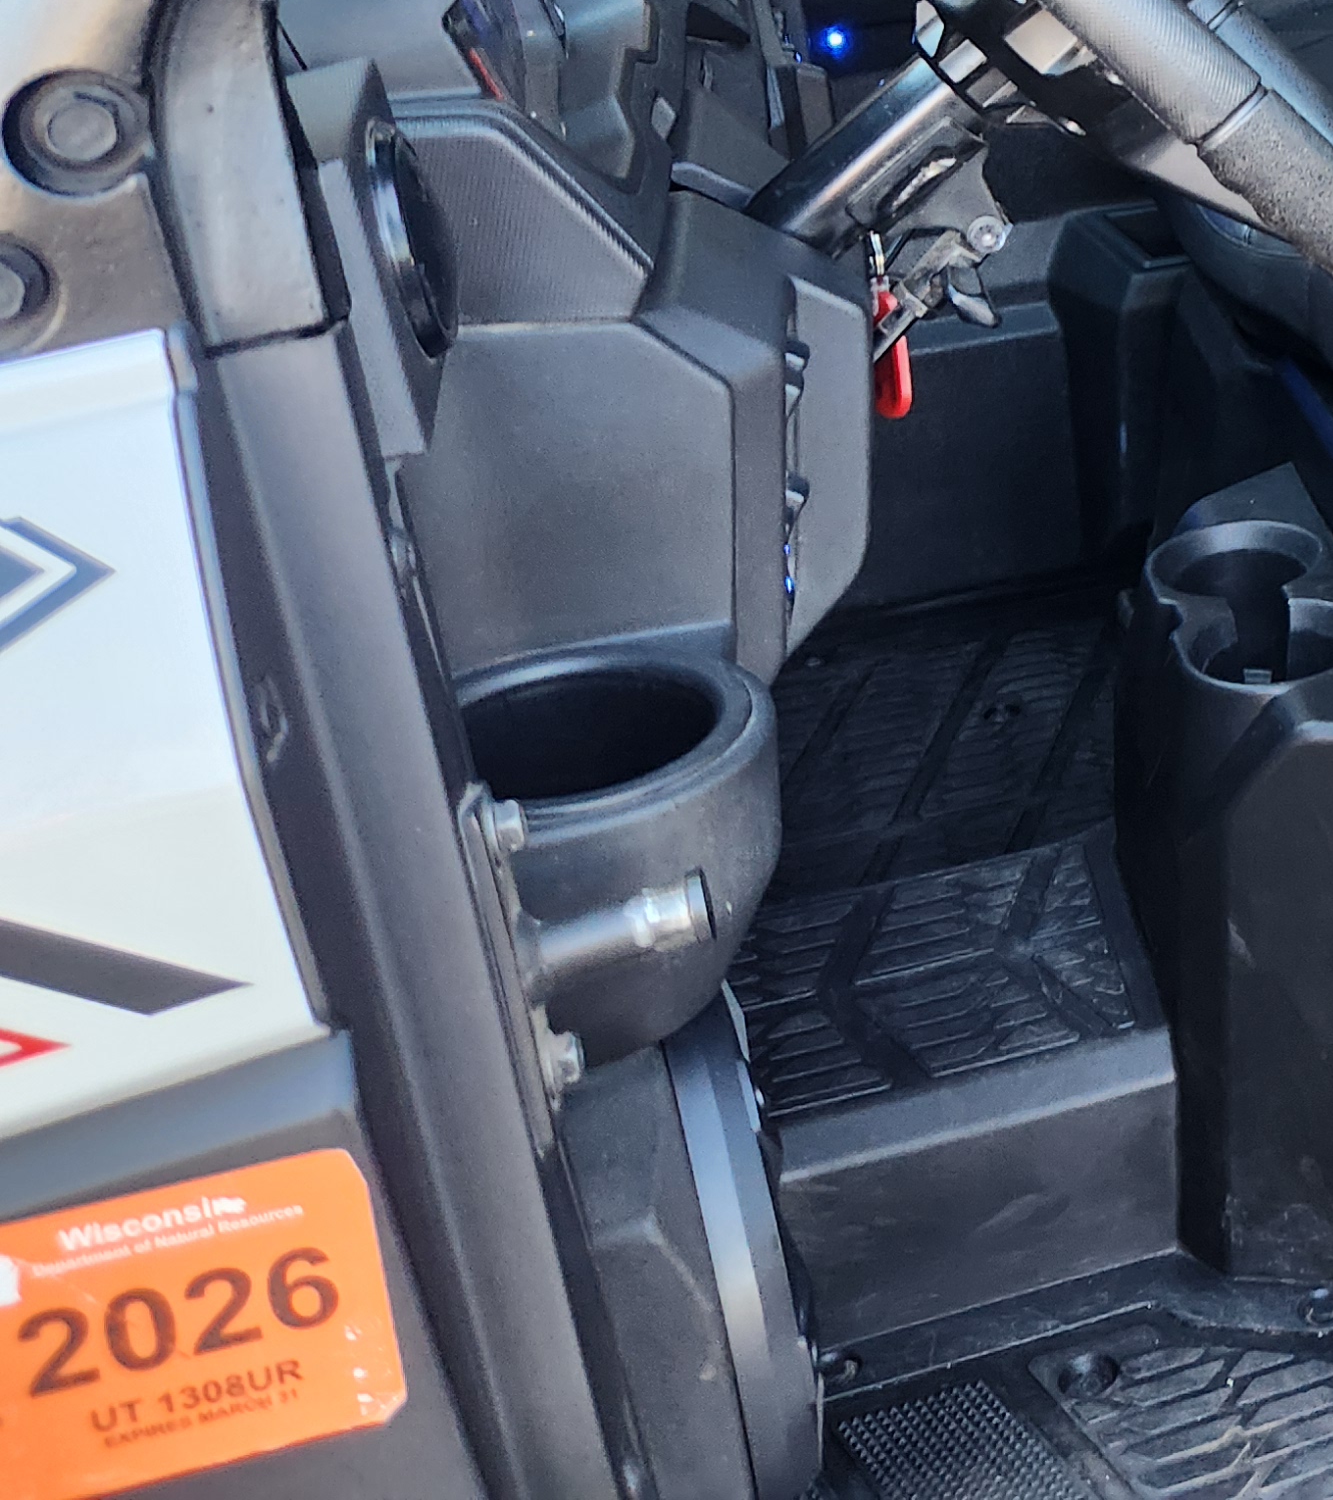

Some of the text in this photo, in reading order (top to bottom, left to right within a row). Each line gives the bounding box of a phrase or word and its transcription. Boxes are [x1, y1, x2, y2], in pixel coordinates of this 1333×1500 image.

[134, 1236, 153, 1254] of
[154, 1223, 216, 1250] Natural
[218, 1203, 306, 1233] Resources
[17, 1245, 340, 1398] 2026
[90, 1358, 304, 1433] UT 1308UR
[104, 1414, 193, 1448] EXPIRES
[198, 1393, 273, 1425] MARCH
